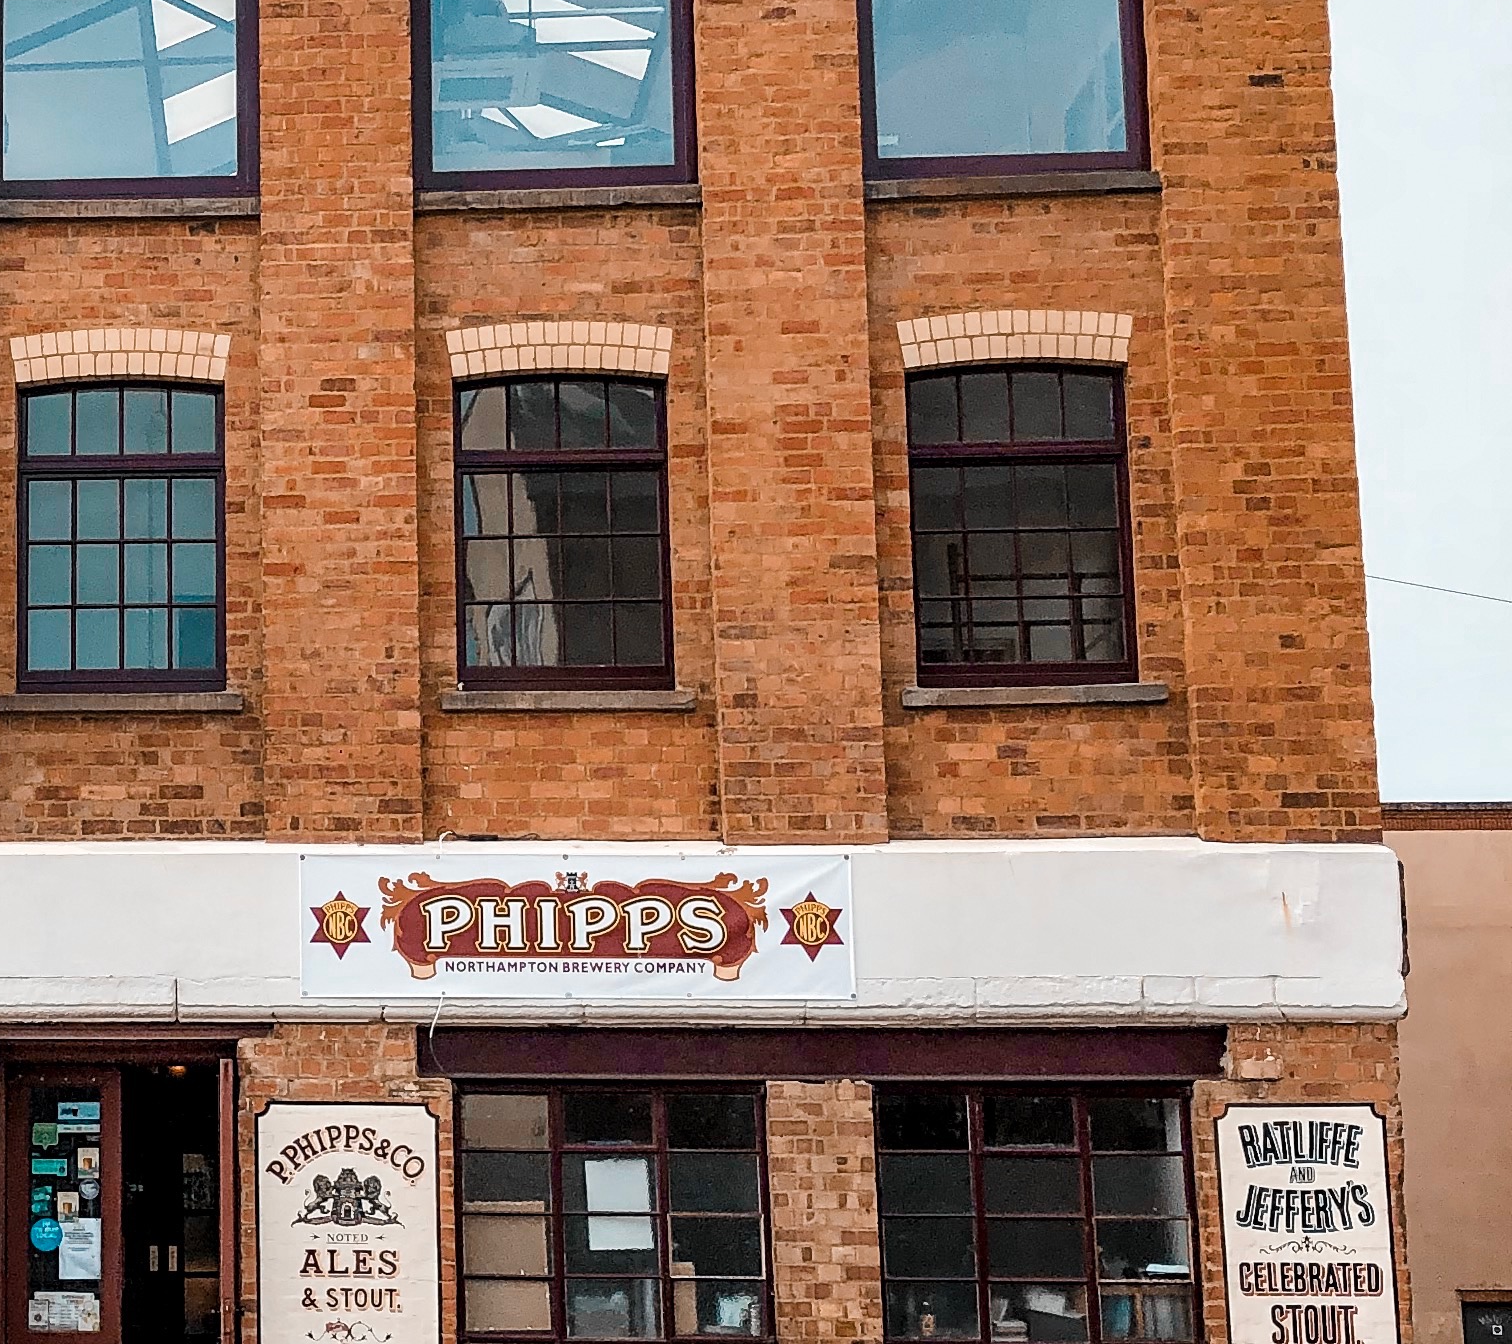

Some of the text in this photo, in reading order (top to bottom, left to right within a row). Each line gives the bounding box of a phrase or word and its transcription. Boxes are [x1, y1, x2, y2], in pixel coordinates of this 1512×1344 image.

[324, 902, 355, 914] PHIPPS
[794, 903, 827, 916] PHIPPS
[328, 911, 354, 940] NBC
[420, 895, 727, 954] PHIPPS
[799, 913, 826, 942] NBC
[445, 960, 707, 974] NORTHAMPTON BREWERY COMPANY
[1238, 1120, 1364, 1169] RATLIFFE
[1289, 1166, 1316, 1184] AND
[1236, 1180, 1376, 1234] JEFFERY'S
[326, 1232, 369, 1244] NOTED
[299, 1249, 401, 1279] ALES
[1239, 1261, 1384, 1297] CELEBRATED
[301, 1287, 403, 1313] & STOUT.
